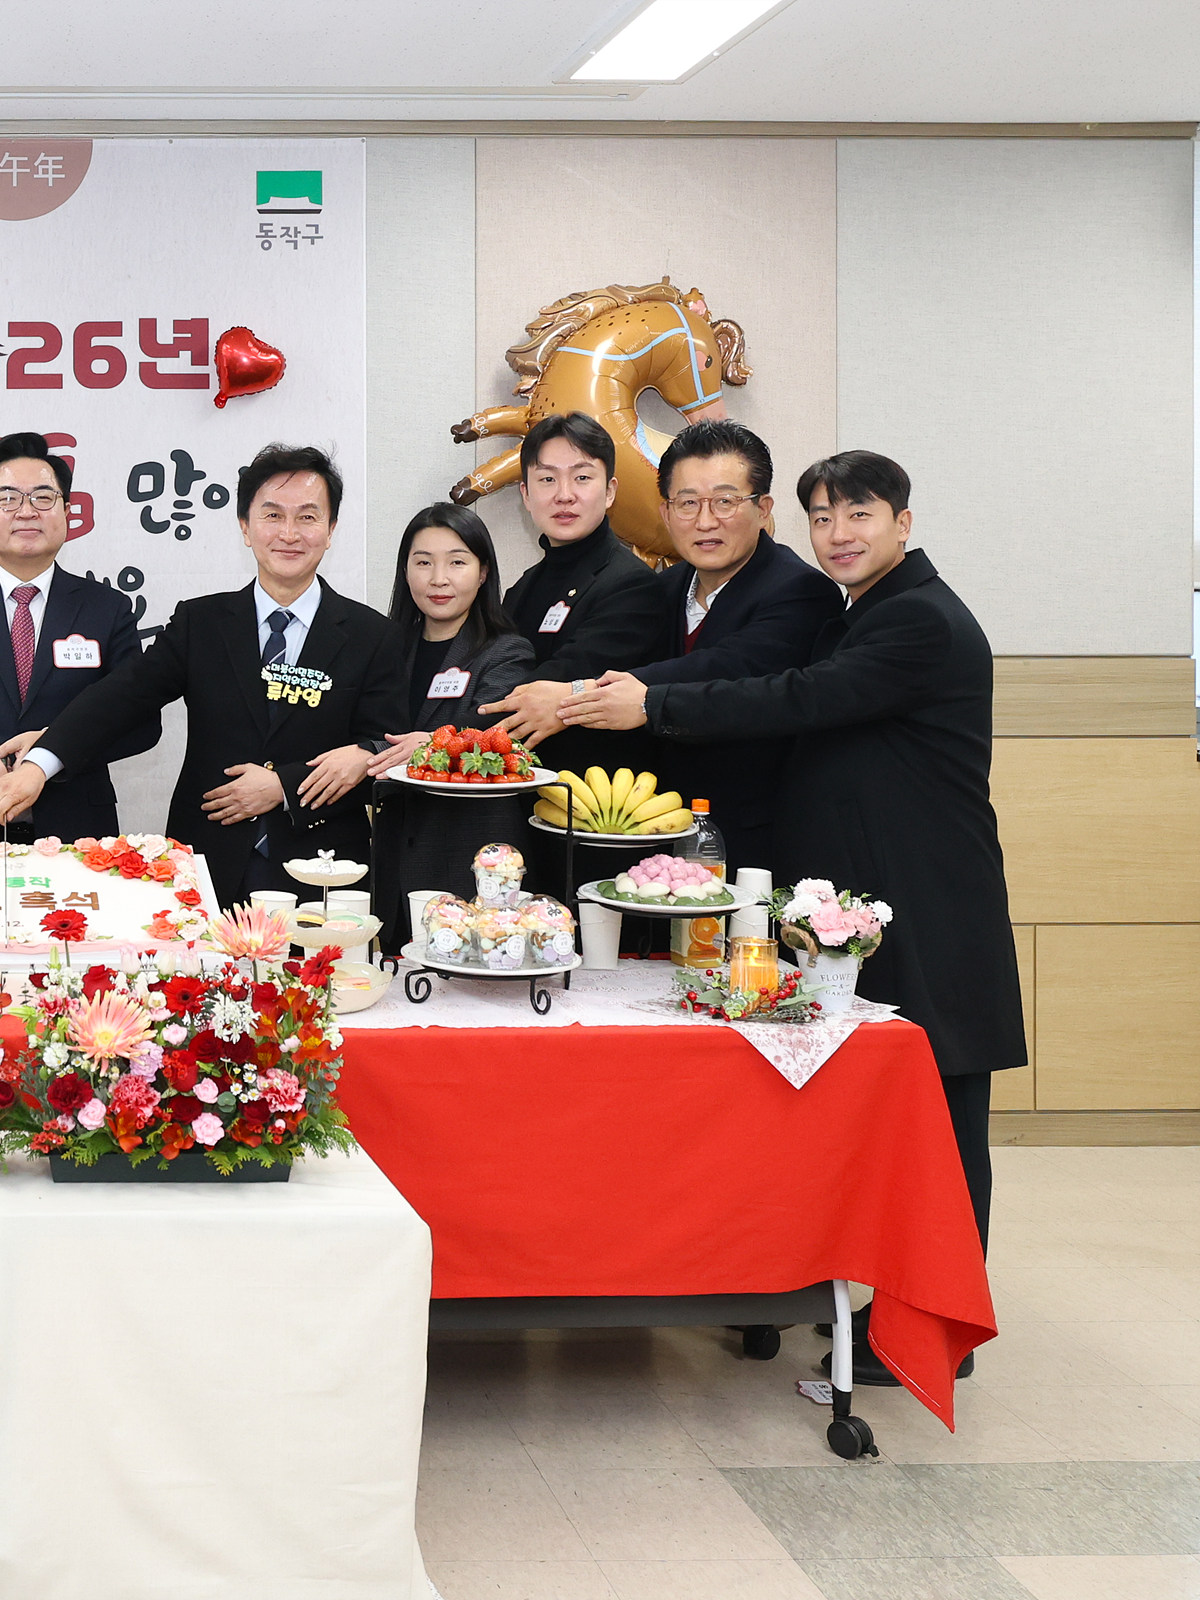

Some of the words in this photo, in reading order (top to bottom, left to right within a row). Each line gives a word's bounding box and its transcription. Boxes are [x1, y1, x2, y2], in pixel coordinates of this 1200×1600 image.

[255, 223, 324, 250] 동작구
[266, 681, 322, 708] 류삼영
[19, 891, 100, 911] 흑석
